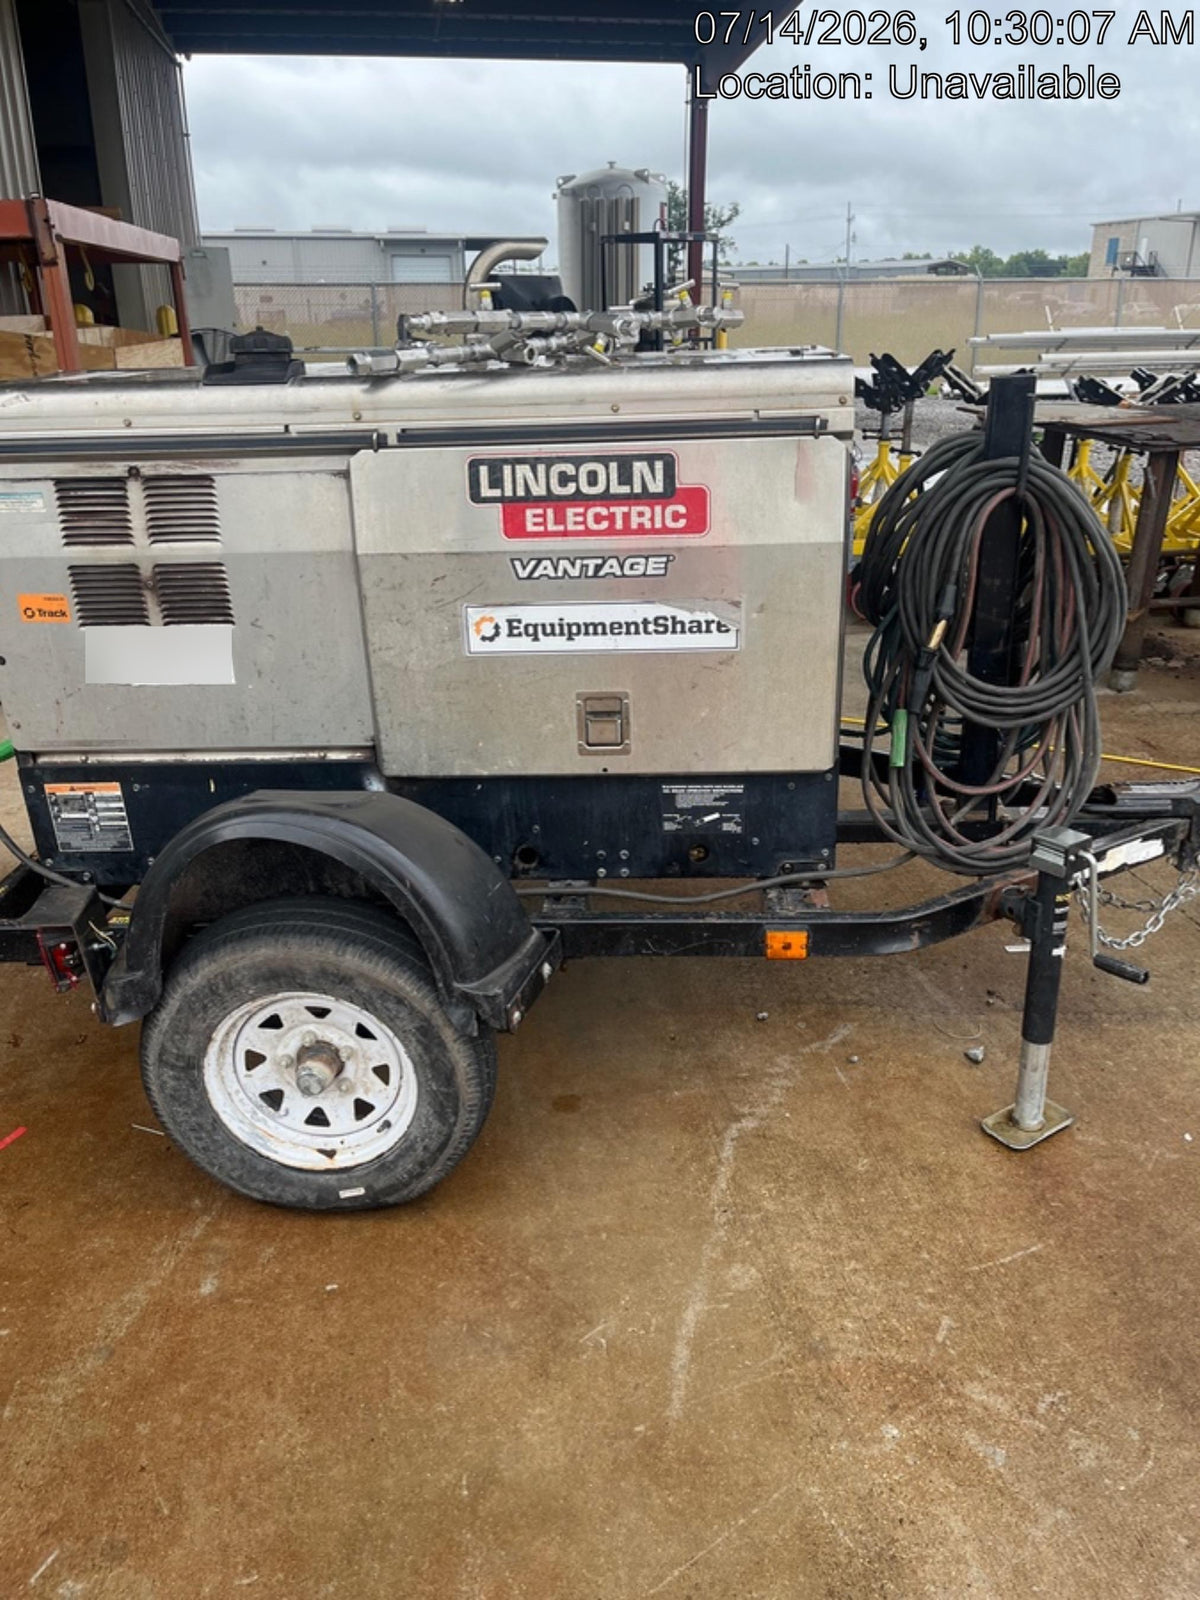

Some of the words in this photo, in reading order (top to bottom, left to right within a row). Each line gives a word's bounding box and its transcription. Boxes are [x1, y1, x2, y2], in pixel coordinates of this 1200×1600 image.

[479, 460, 664, 497] LINCOLN
[525, 504, 688, 532] ELECTRIC
[511, 555, 669, 579] VANTAGE
